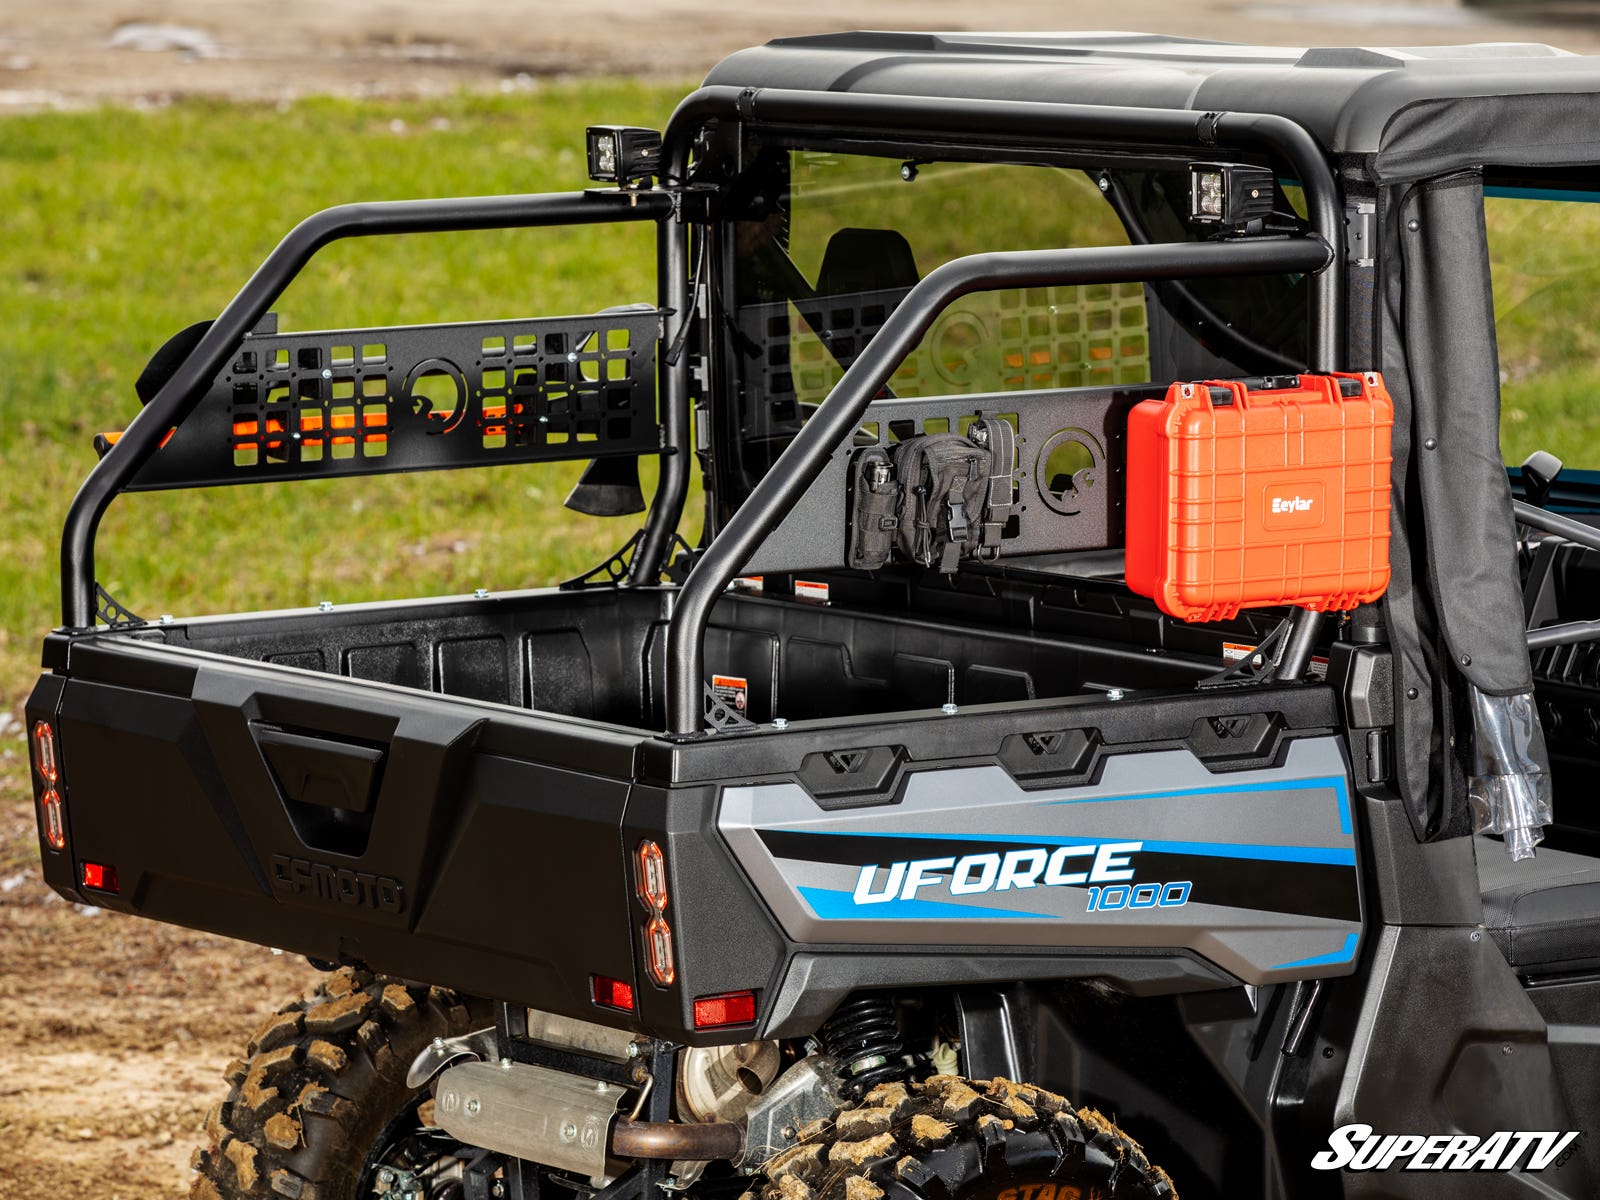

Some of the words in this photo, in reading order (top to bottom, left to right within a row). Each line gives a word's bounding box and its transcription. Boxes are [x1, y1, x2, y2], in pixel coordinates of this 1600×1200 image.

[271, 854, 404, 914] CFMOTO
[852, 841, 1144, 905] UFORCE
[1085, 881, 1193, 912] 1000
